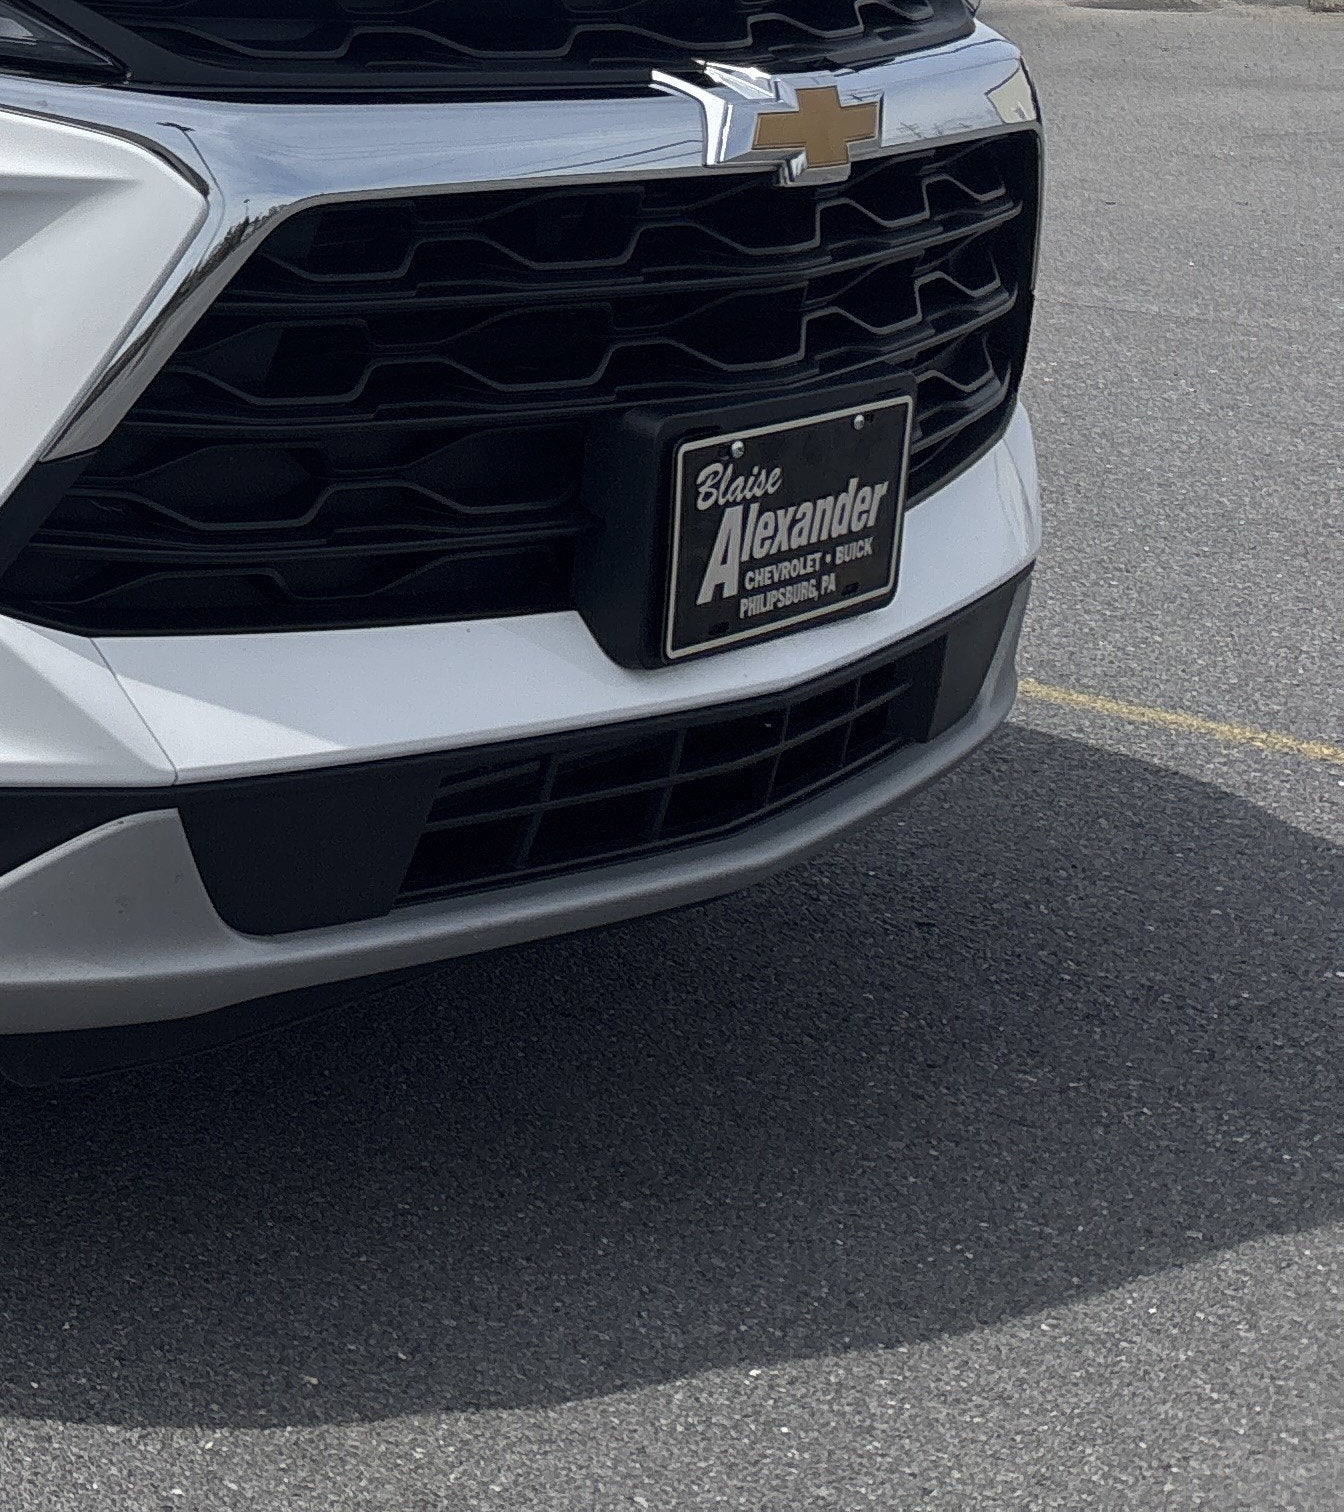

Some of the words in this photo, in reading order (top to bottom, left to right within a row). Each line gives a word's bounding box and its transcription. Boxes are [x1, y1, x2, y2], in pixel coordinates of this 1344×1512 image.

[696, 462, 782, 511] Blaise
[695, 477, 889, 606] Alexander
[744, 551, 823, 590] CHEVROLET
[835, 537, 874, 566] BUICK
[739, 578, 819, 619] PHILIPSBURG,
[820, 572, 836, 596] PA
